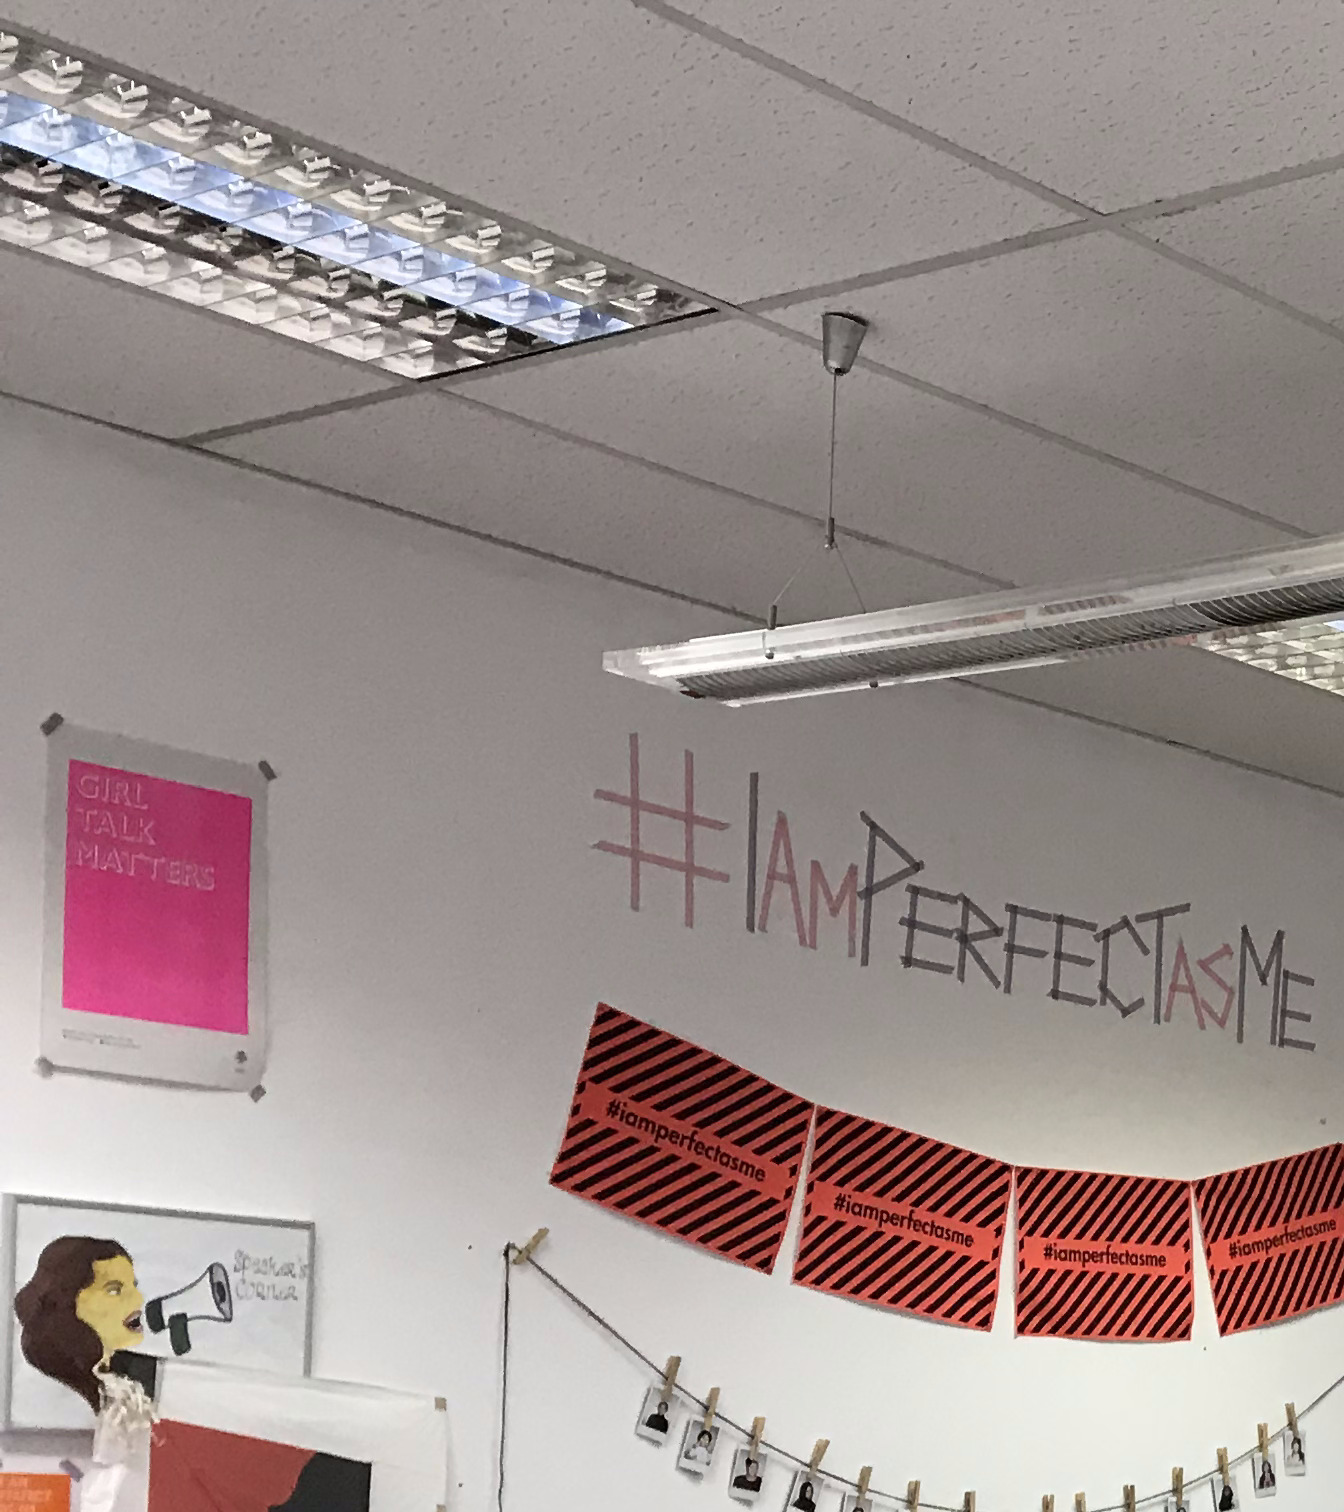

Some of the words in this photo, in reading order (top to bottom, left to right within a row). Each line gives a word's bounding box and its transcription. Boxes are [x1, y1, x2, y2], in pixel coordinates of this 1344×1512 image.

[76, 775, 148, 810] GIRL
[76, 808, 156, 846] TALK
[76, 841, 215, 891] MATTERS
[605, 1098, 767, 1183] #iamperfectasme
[833, 1192, 975, 1248] #iamperfectasme
[1229, 1217, 1337, 1259] #iamperfectasme
[1042, 1242, 1167, 1268] #iamperfectasme
